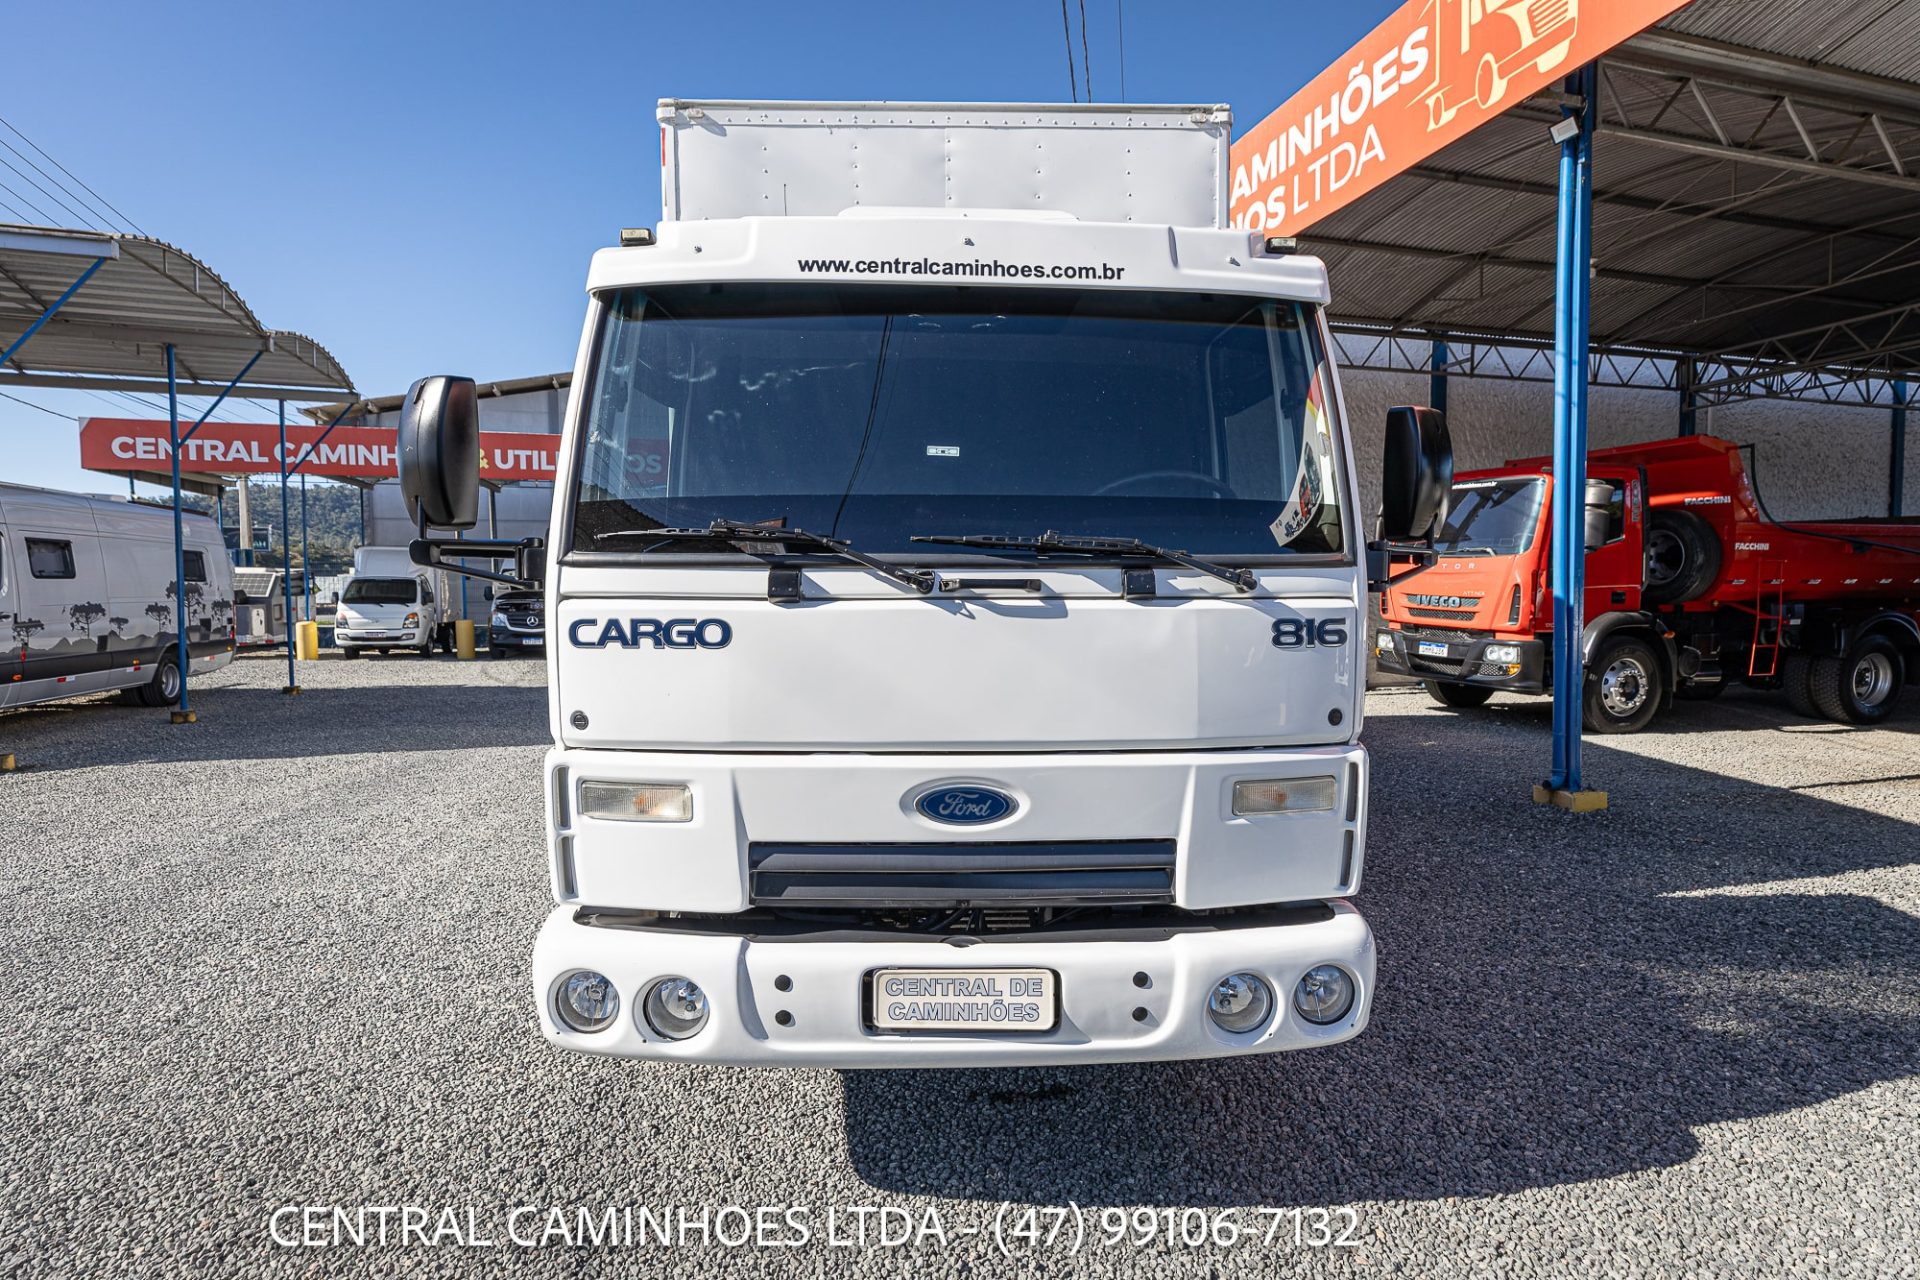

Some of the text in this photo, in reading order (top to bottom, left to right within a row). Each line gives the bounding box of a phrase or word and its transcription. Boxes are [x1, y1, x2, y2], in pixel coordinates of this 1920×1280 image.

[1230, 25, 1429, 208] AMINHÕES
[1293, 123, 1386, 216] LTDA
[797, 257, 1125, 280] www.centralcaminhoes.com.br
[110, 436, 269, 463] CENTRAL
[273, 441, 399, 467] CAMINH
[1684, 495, 1731, 506] FACCHINI
[1734, 542, 1769, 551] FACCHINI
[1416, 594, 1462, 608] IVECO
[568, 618, 733, 650] CARGO
[1271, 617, 1348, 648] 816
[938, 792, 992, 816] Ford
[885, 978, 1043, 997] CENTRAL DE
[888, 999, 1040, 1023] CAMINHÕES
